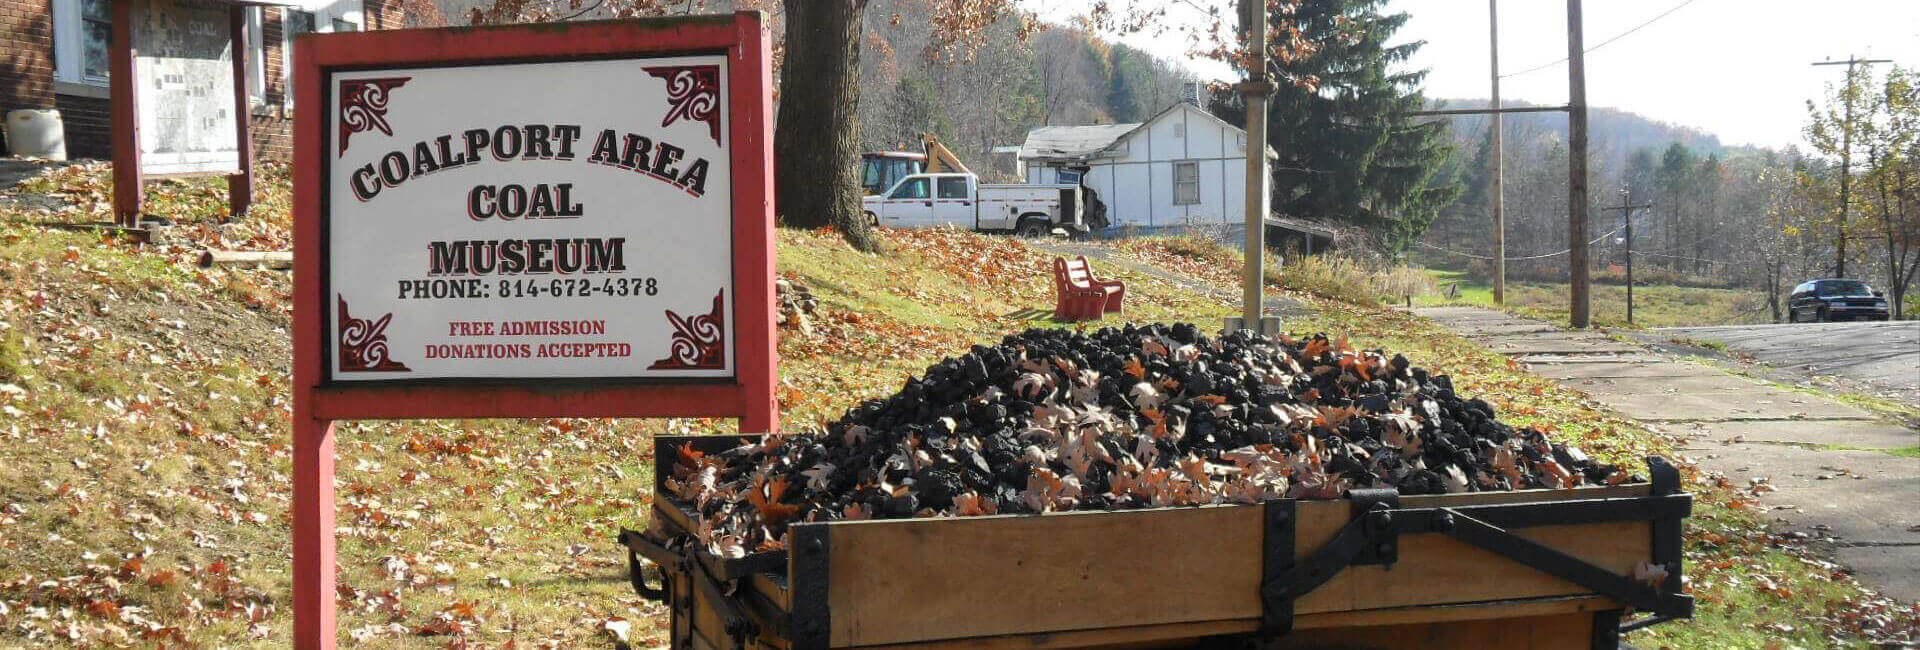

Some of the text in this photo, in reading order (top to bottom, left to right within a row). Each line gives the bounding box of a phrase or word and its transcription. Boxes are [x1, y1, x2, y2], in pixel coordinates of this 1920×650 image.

[350, 124, 711, 202] COALPORT AREA
[467, 183, 584, 221] COAL
[428, 237, 626, 277] MUSEUM
[398, 277, 659, 300] PHONE: 814-672-4378
[448, 320, 606, 337] FREE ADMISSION
[425, 343, 632, 360] DONATIONS ACCEPTED
